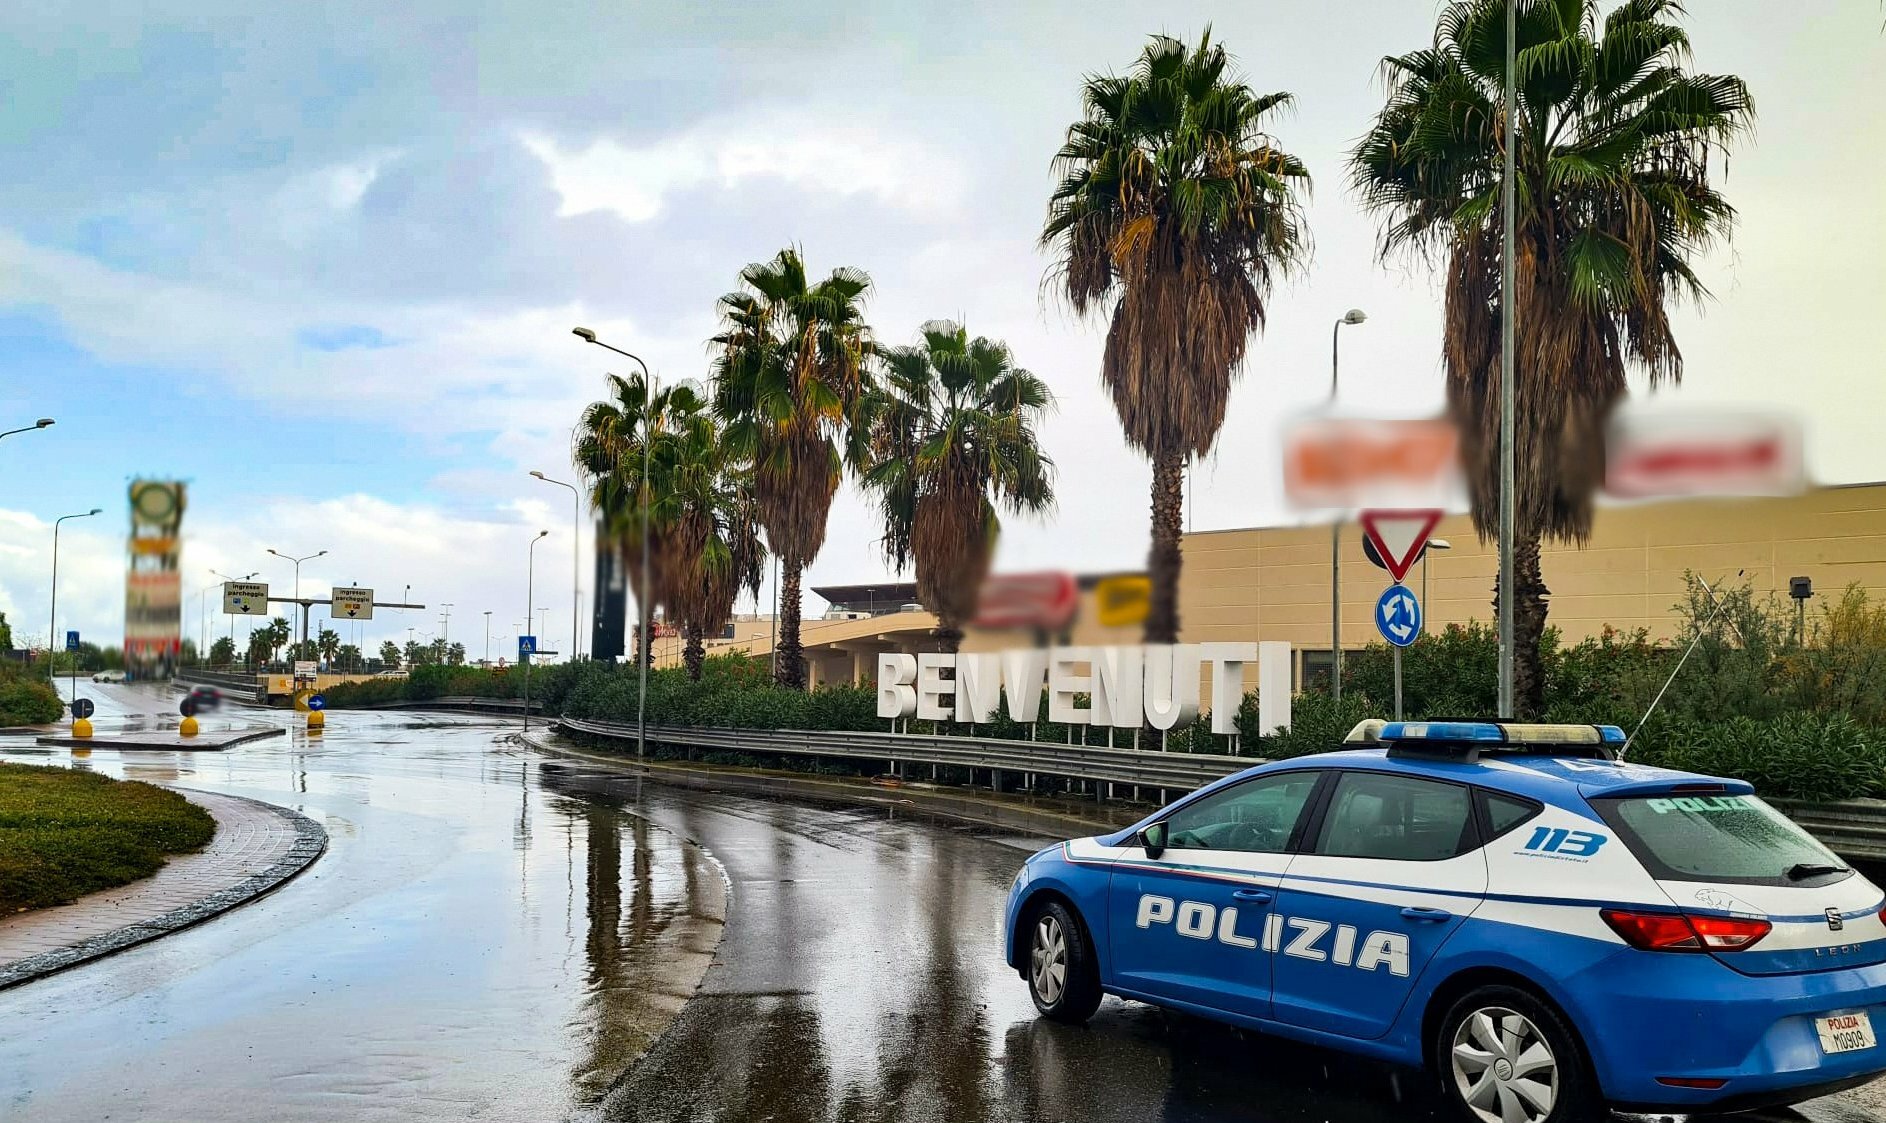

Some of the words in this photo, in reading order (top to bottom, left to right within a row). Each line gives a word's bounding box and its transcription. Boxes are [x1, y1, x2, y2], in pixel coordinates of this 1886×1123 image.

[877, 641, 1292, 738] BENVENUTI
[1525, 826, 1608, 857] 113
[1136, 893, 1410, 978] POLIZIA
[1815, 944, 1861, 957] LEON
[1828, 1016, 1859, 1031] POLIZIA
